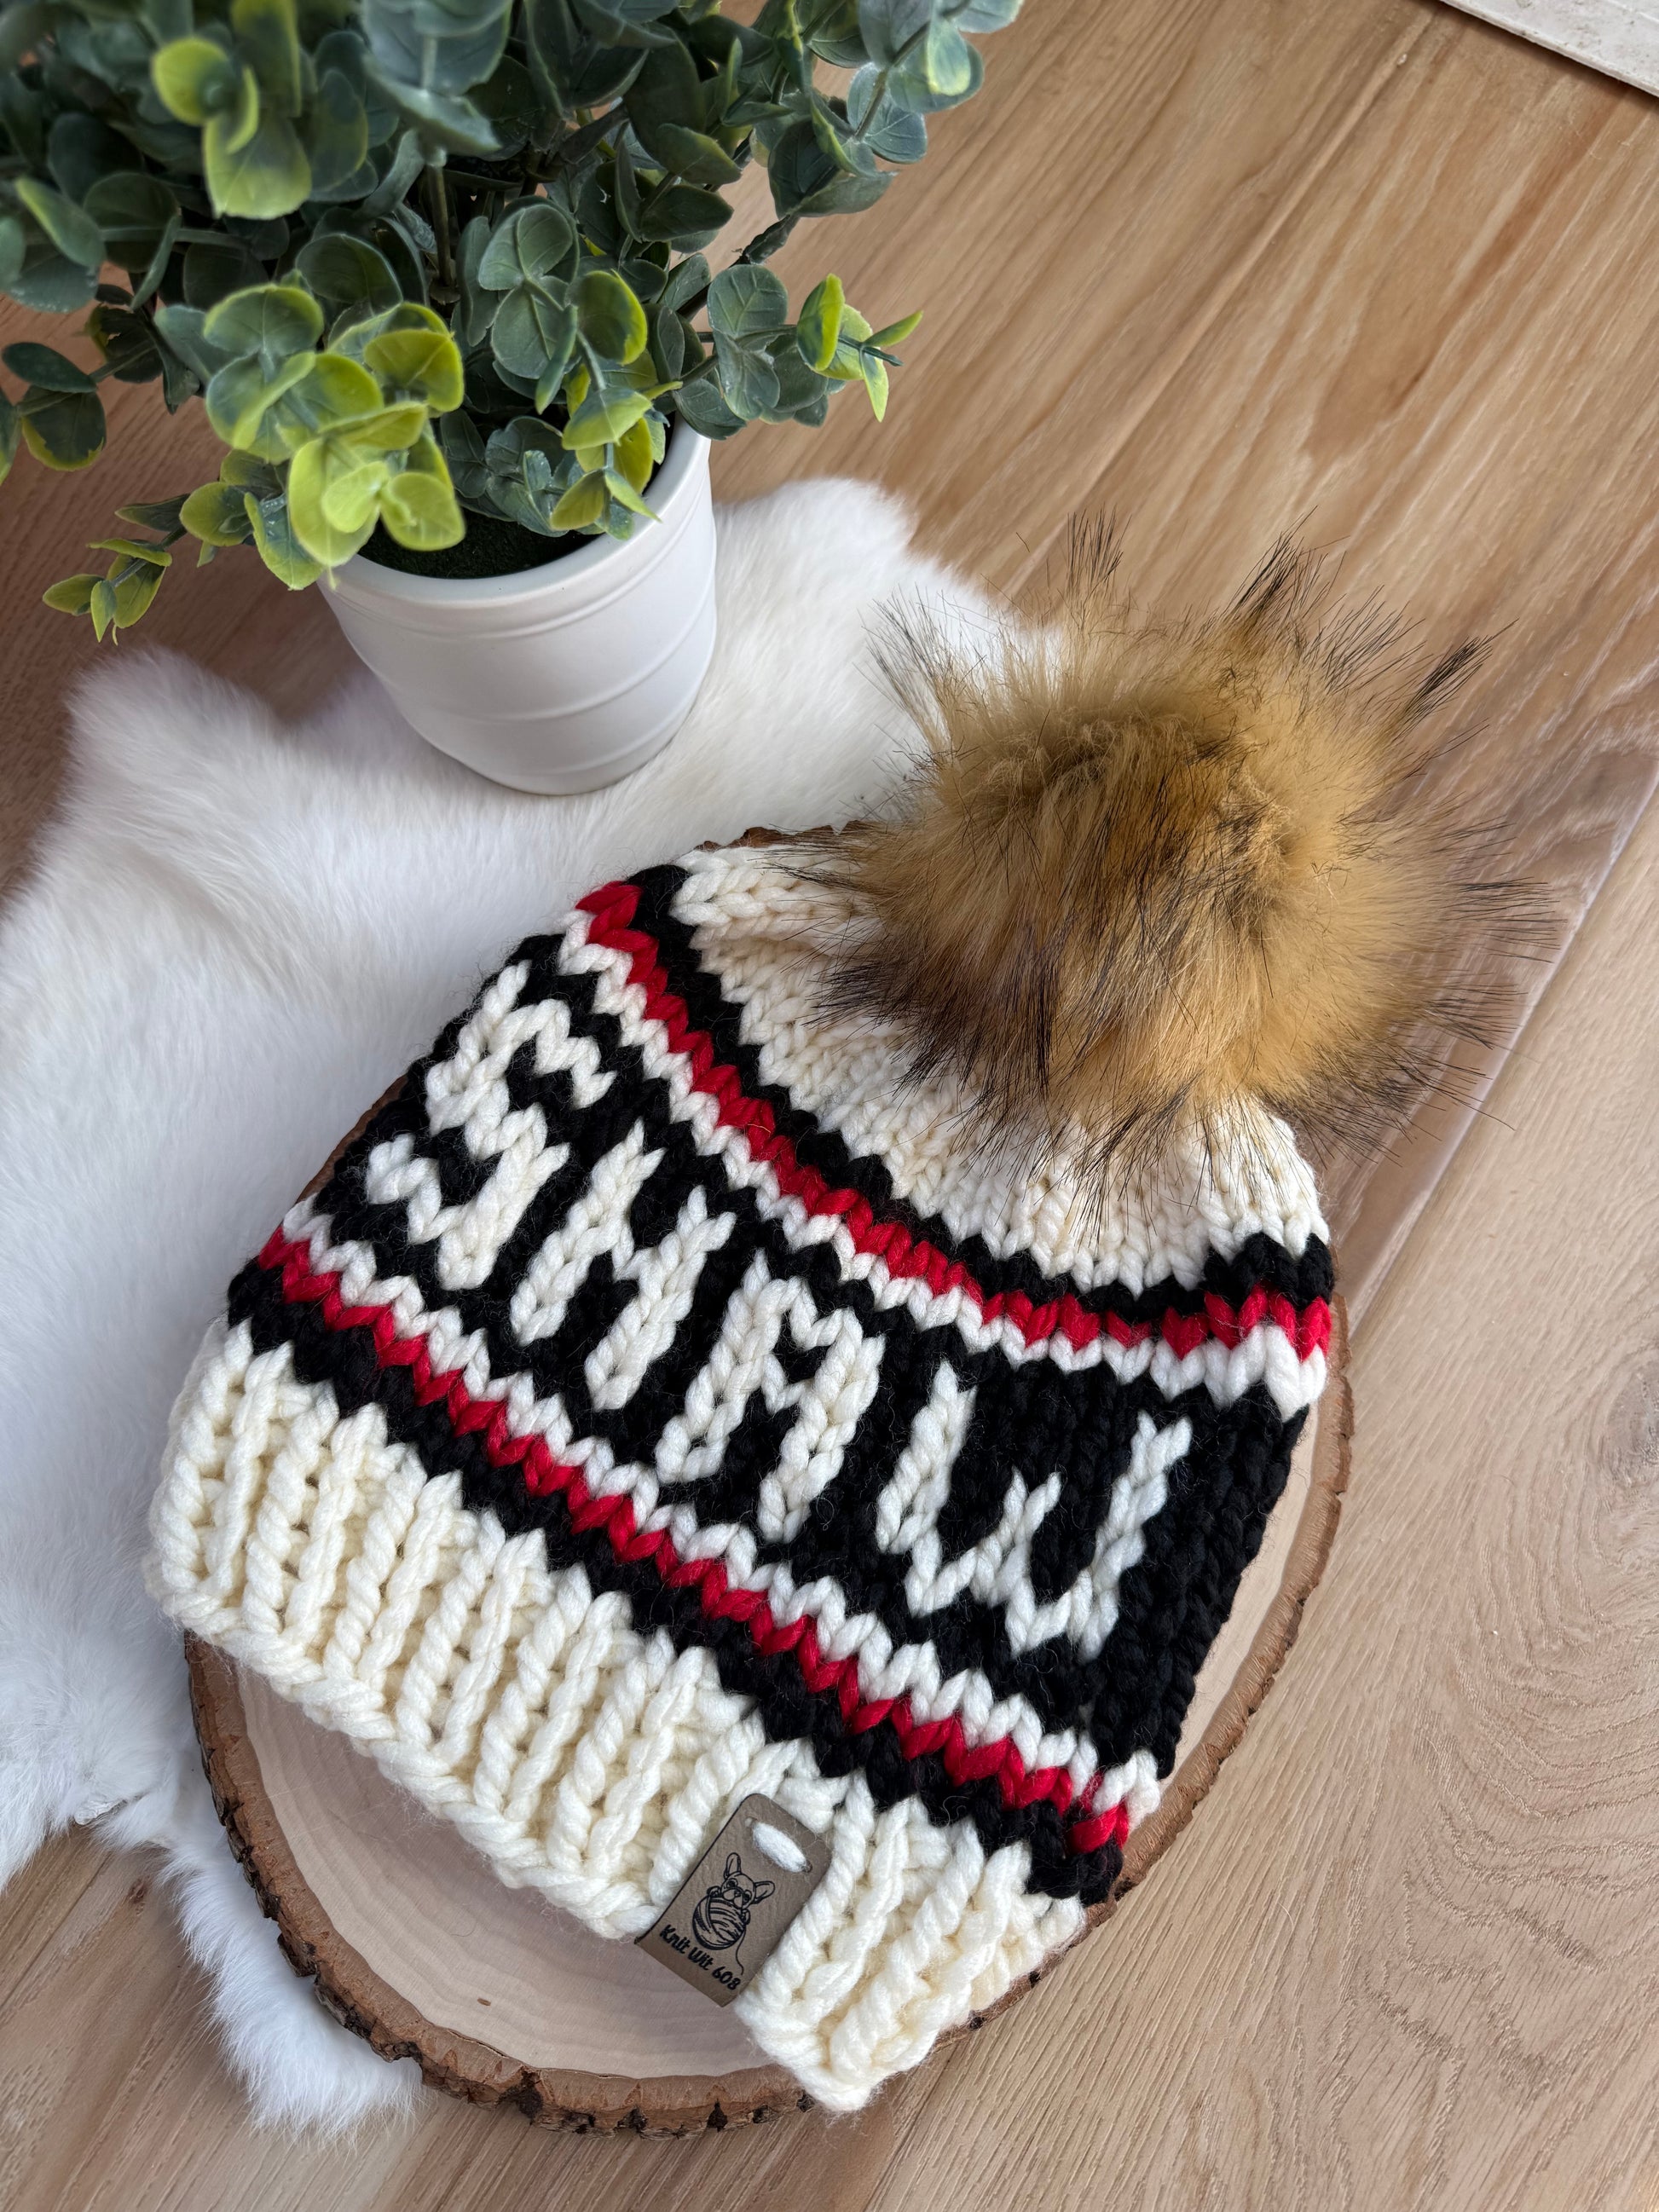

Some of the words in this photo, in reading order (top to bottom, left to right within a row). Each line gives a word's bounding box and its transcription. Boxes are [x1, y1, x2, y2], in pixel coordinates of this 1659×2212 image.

[366, 961, 1193, 1655] SHAW
[659, 1924, 691, 1954] Knit
[687, 1947, 714, 1970] Wit
[712, 1966, 741, 1990] 608
